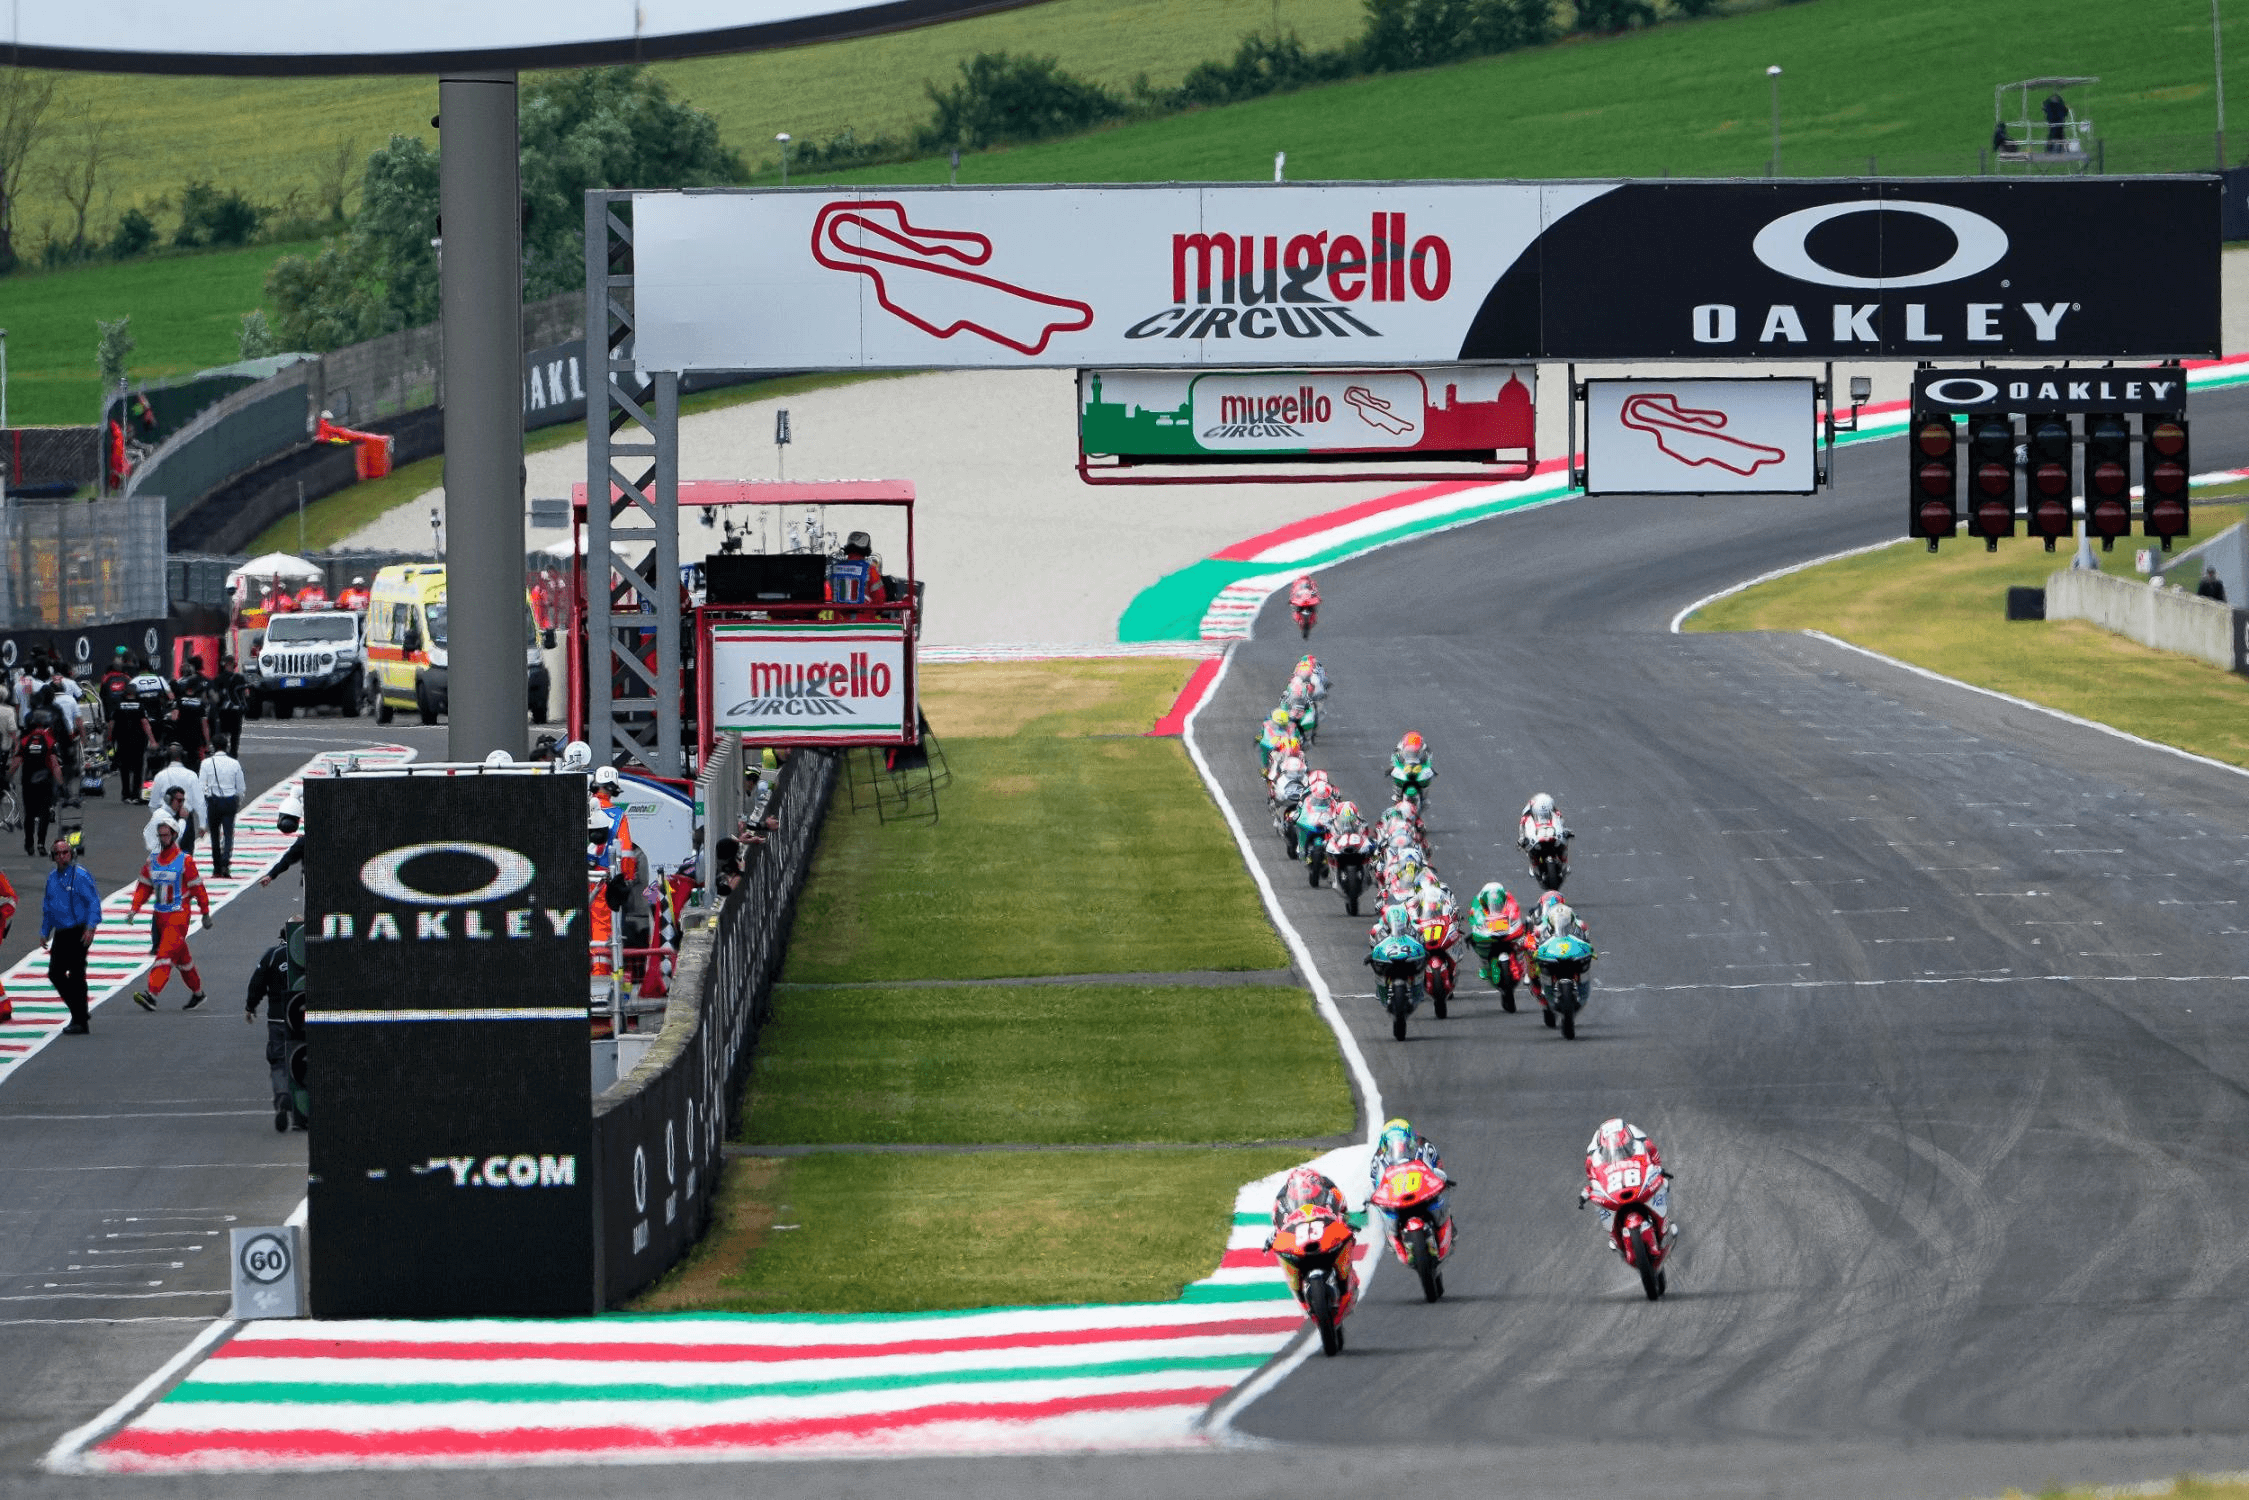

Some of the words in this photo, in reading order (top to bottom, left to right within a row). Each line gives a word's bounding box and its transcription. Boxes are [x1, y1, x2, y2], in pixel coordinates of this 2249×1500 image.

[1173, 211, 1452, 306] mugello
[1124, 306, 1384, 339] CIRCUIT
[1692, 302, 2073, 343] OAKLEY
[1221, 386, 1332, 424] mugello
[2009, 381, 2173, 400] OAKLEY
[1203, 424, 1305, 438] CIRCUIT
[751, 652, 891, 698] mugello
[726, 699, 856, 717] CIRCUIT
[321, 908, 577, 940] OAKLEY
[250, 1250, 282, 1271] 60
